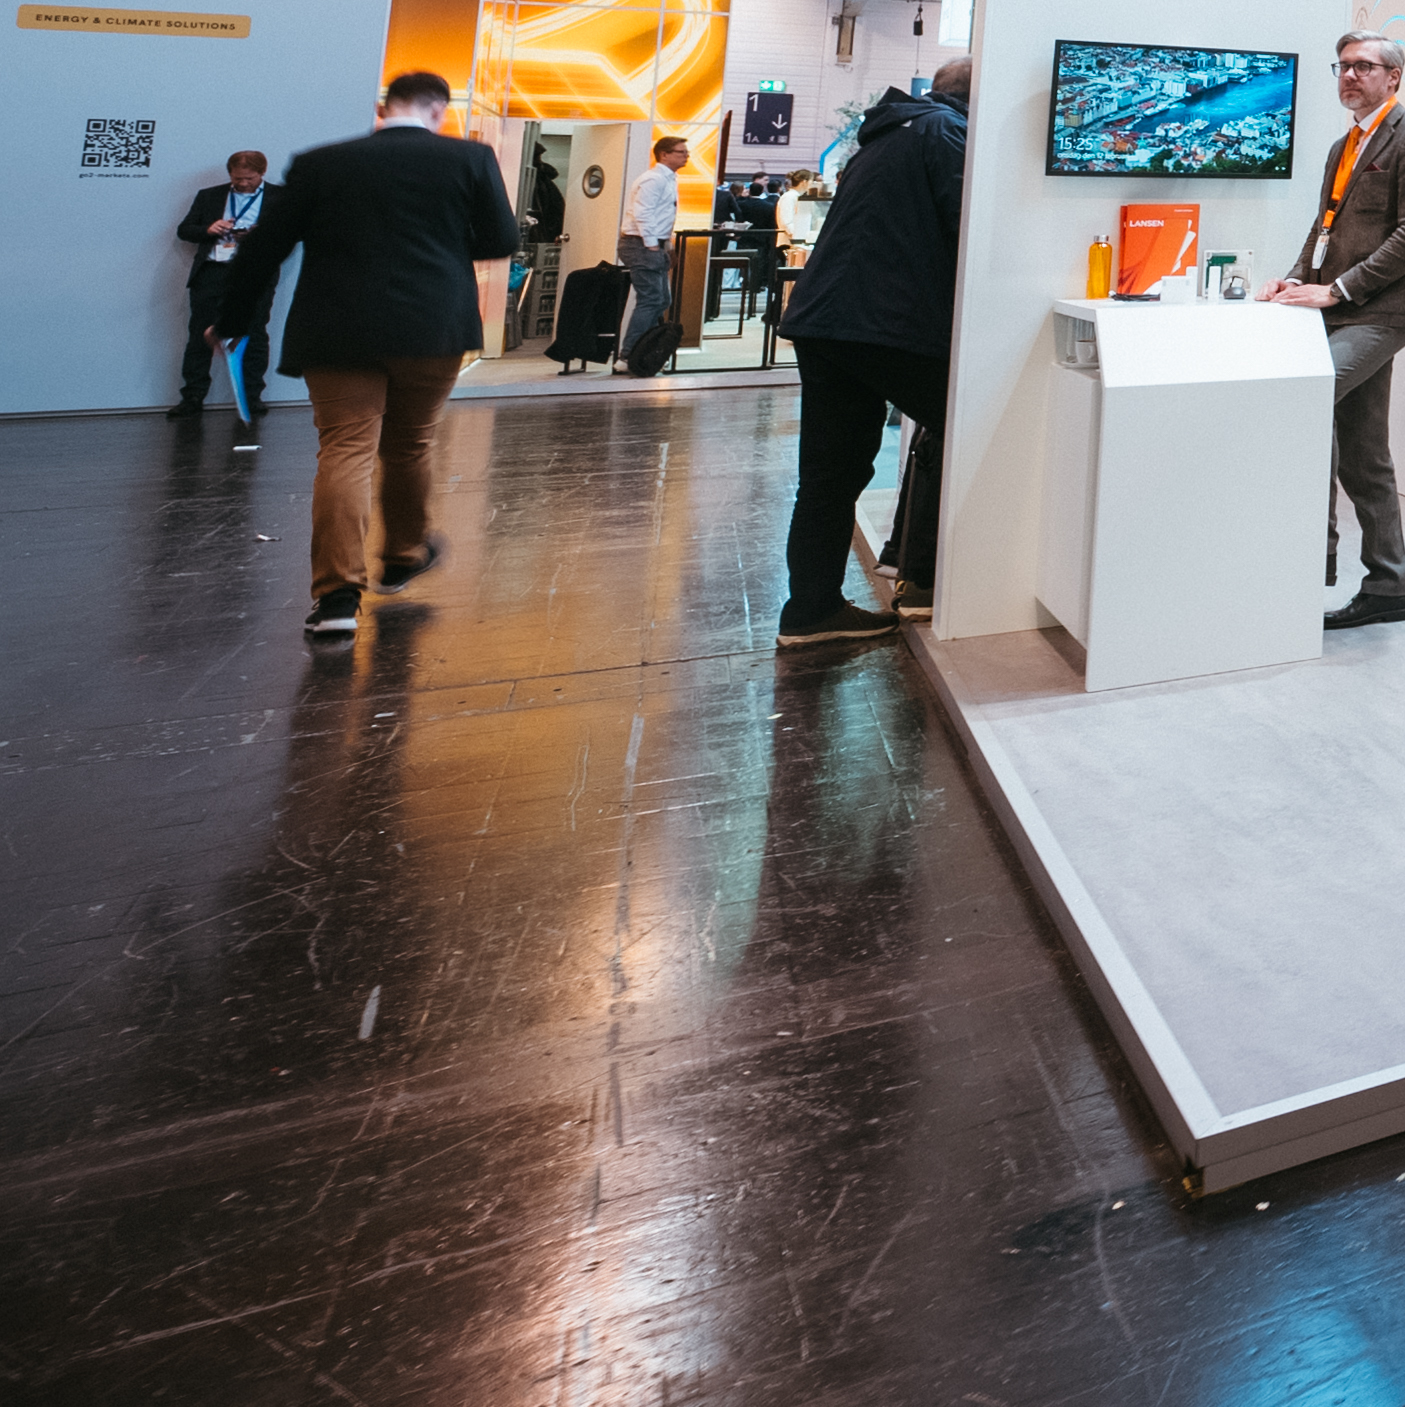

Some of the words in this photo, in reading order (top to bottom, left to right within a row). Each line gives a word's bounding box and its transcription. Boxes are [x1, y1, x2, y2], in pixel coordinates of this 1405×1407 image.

[35, 13, 89, 24] ENERGY
[93, 16, 101, 24] &
[106, 17, 162, 28] CLIMATE
[166, 20, 236, 31] SOLUTIONS
[748, 94, 759, 112] 1
[744, 132, 760, 143] 1A
[1058, 137, 1093, 151] 15:25
[1129, 219, 1165, 228] LANSEN
